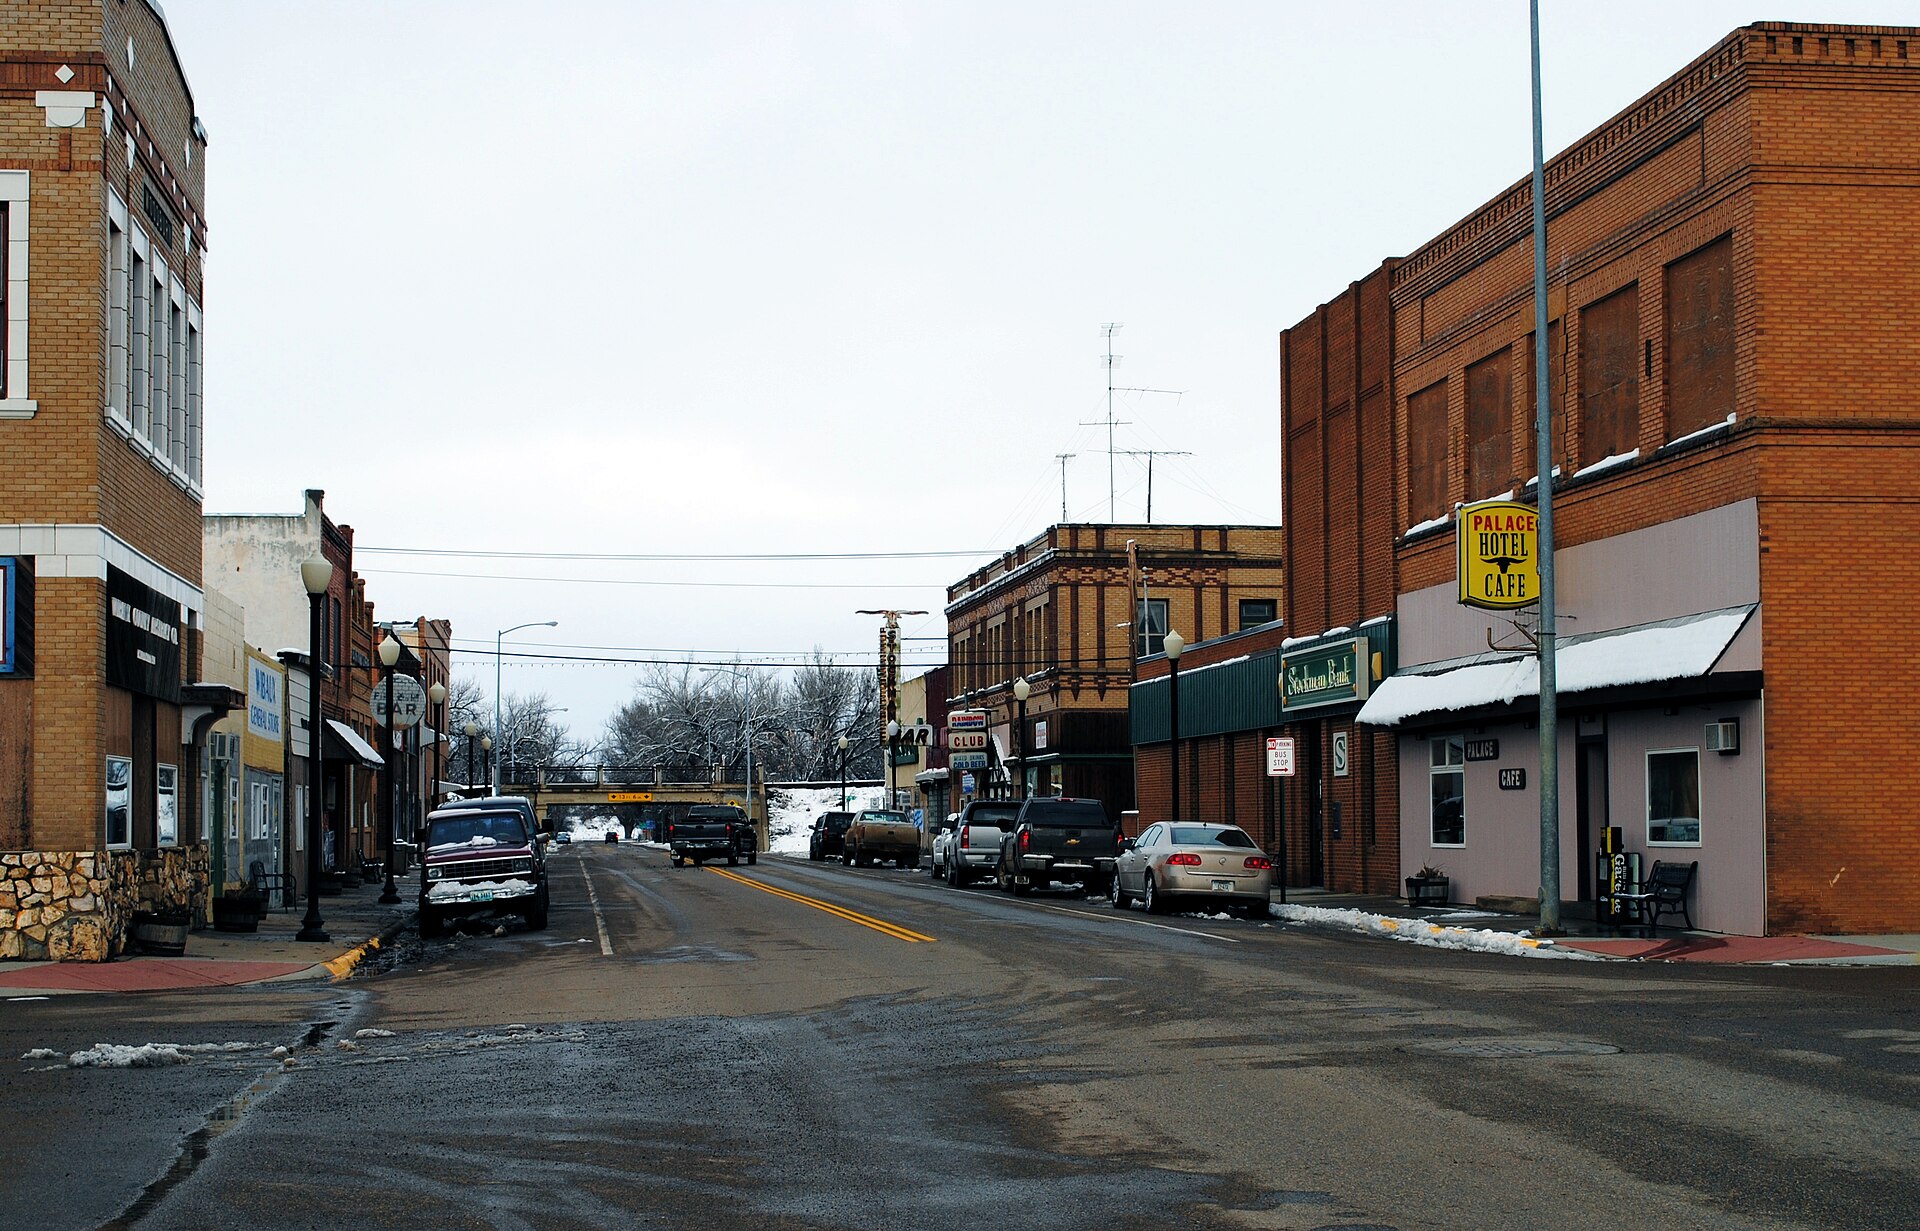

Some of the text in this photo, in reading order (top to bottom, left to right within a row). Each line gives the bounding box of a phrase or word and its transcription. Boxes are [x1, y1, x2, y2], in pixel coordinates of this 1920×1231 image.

[1473, 515, 1535, 531] PALACE
[1479, 532, 1529, 557] HOTEL
[1484, 573, 1526, 598] CAFE
[1287, 655, 1352, 696] Stockman Bank
[377, 702, 417, 717] BAR
[954, 736, 984, 747] CLUB
[1467, 741, 1494, 758] PALACE
[970, 760, 986, 768] BEER
[1501, 770, 1521, 787] CAFE
